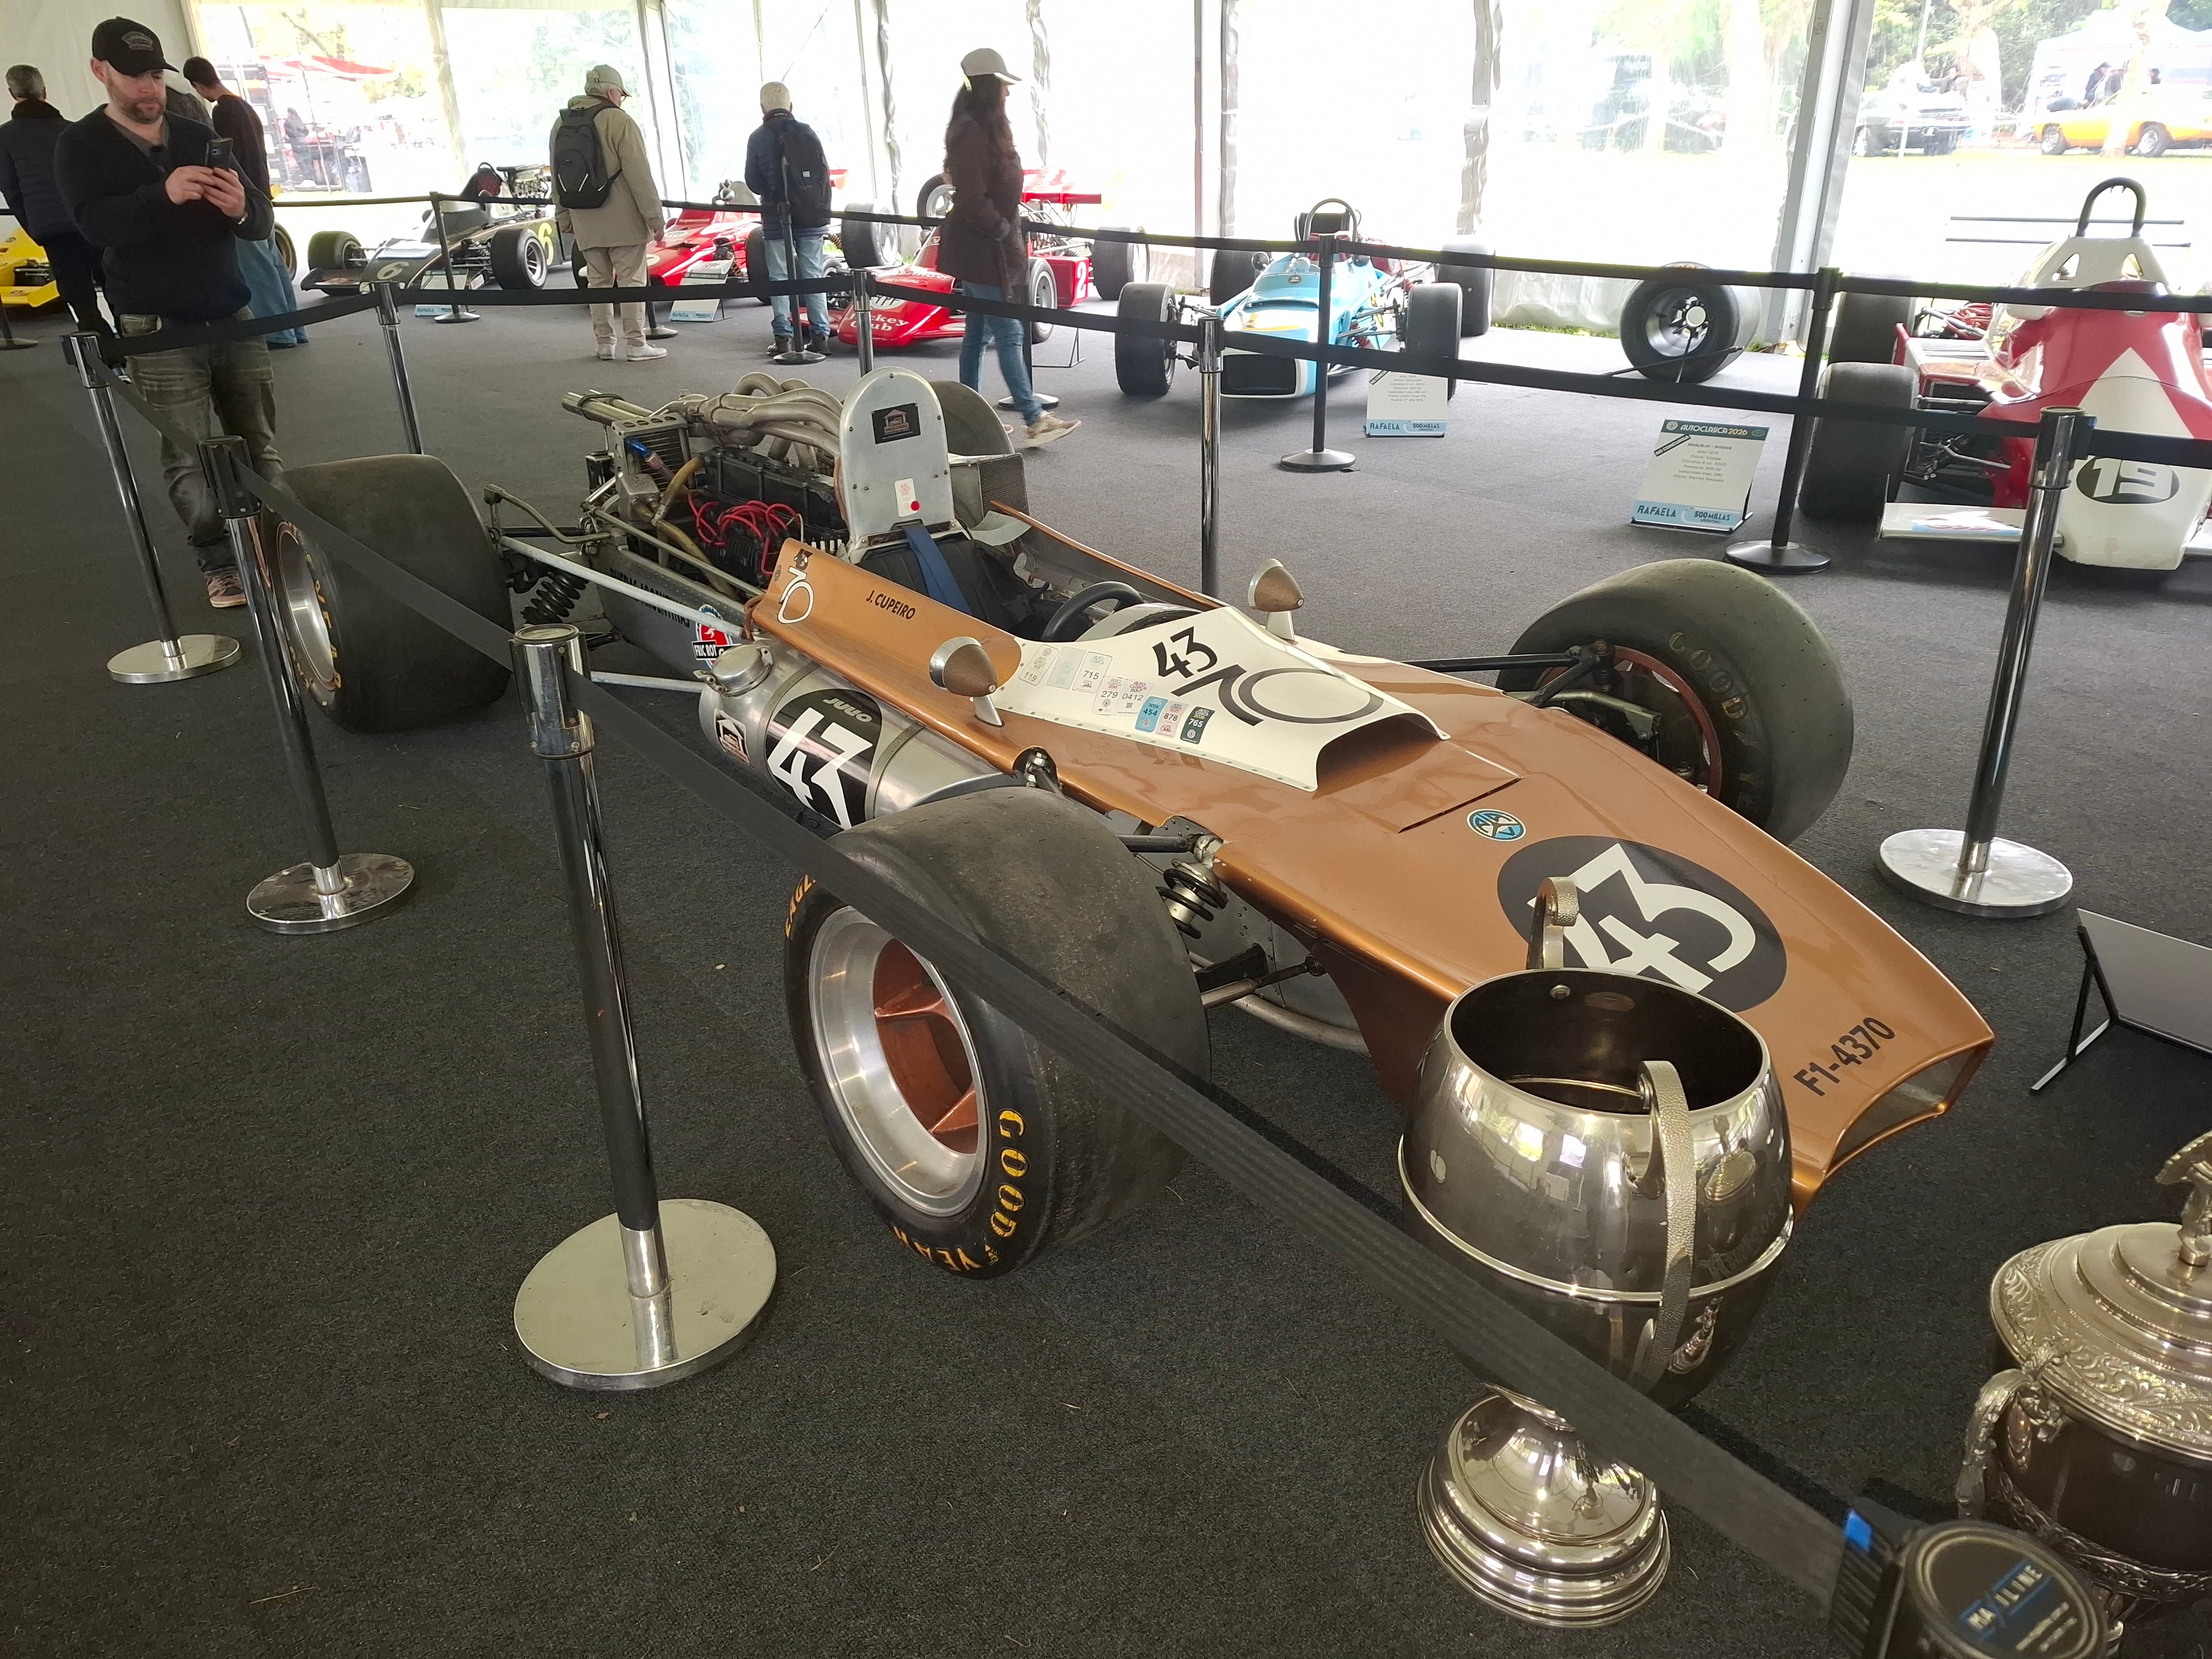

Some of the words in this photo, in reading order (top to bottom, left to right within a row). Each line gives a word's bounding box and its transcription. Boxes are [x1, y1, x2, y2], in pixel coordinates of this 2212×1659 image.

[538, 222, 554, 266] 6
[376, 261, 410, 280] 6
[1076, 261, 1086, 299] 2
[876, 294, 900, 306] YPF
[845, 313, 910, 326] Jkey
[850, 320, 892, 331] Cub
[2092, 457, 2174, 499] 19
[1637, 505, 1676, 518] RAFAELA
[866, 589, 875, 603] J.
[874, 593, 916, 620] CUPEIRO
[693, 644, 706, 657] FRIC
[706, 644, 717, 657] ROT
[1152, 626, 1218, 678] 43
[1024, 671, 1038, 682] 119
[1083, 670, 1100, 680] 715
[1668, 631, 1748, 719] GOOD
[1101, 690, 1118, 698] 279
[1122, 693, 1144, 701] 0412
[1143, 708, 1158, 716] 454
[1163, 713, 1178, 721] 878
[1188, 718, 1204, 728] 765
[785, 873, 817, 940] EAGL
[1526, 842, 1756, 994] 43
[1792, 1017, 1896, 1097] F1-4370
[988, 1108, 1030, 1238] GOOD
